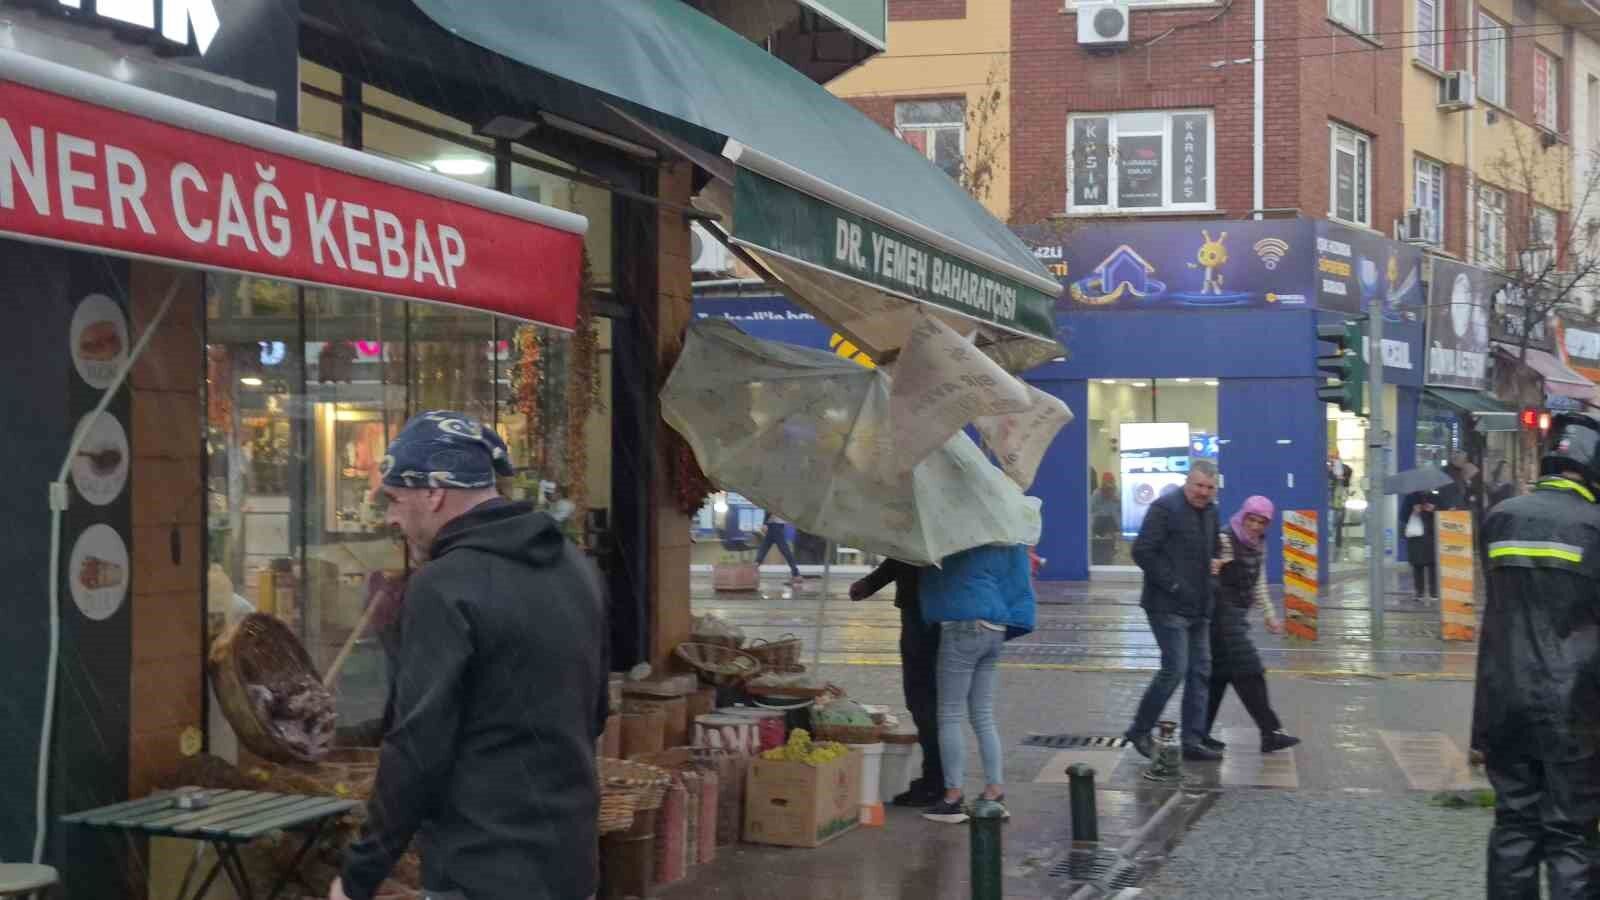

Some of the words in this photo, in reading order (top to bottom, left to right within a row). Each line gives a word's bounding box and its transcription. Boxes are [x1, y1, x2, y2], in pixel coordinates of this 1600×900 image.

[169, 161, 291, 258] CAĞ
[305, 192, 467, 290] KEBAP
[835, 217, 866, 271] DR.
[871, 232, 928, 290] YEMEN
[931, 256, 1017, 322] BAHARATÇISI
